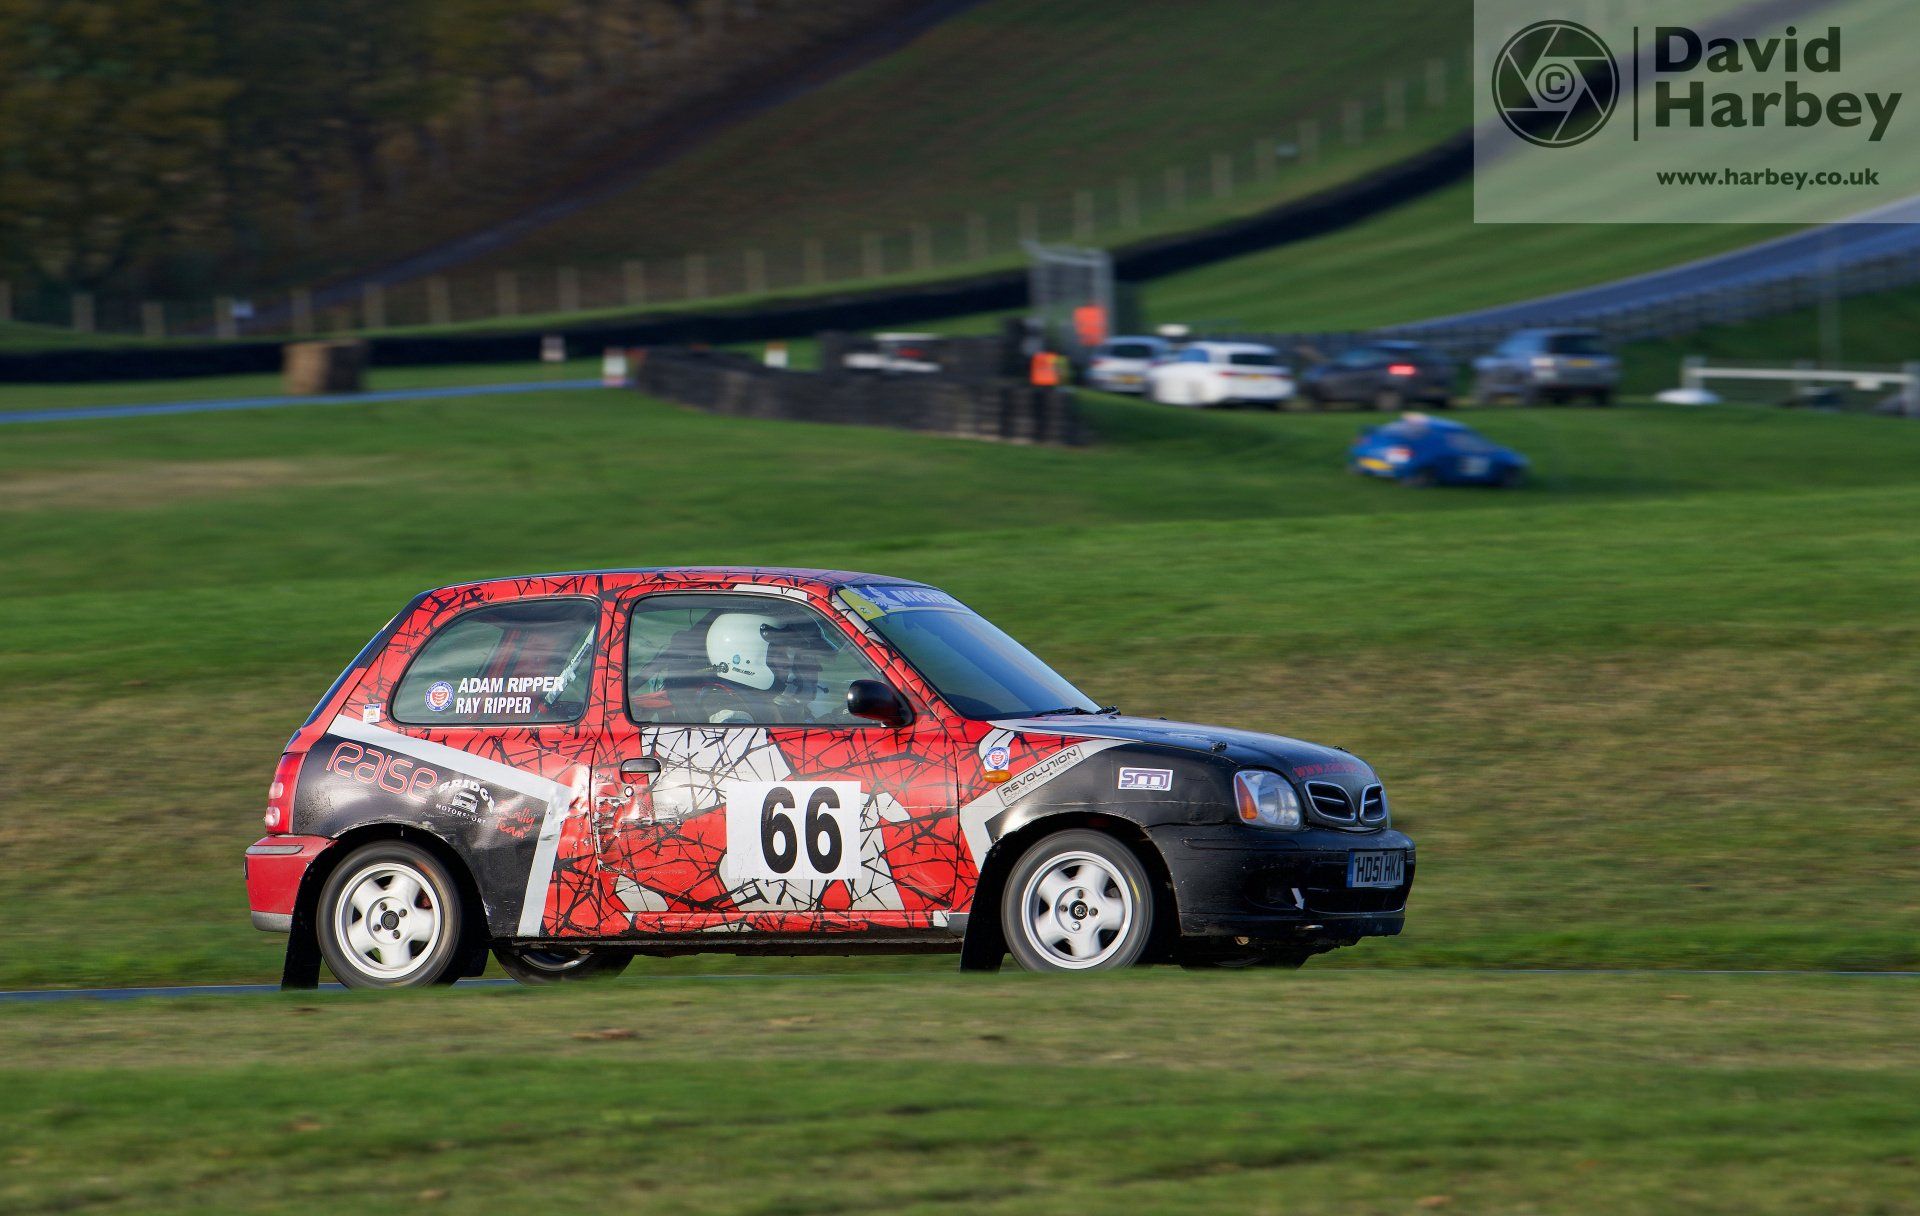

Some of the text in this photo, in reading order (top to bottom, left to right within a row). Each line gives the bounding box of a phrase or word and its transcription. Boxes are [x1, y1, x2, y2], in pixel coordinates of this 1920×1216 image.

[889, 590, 962, 609] MICHEL
[458, 676, 564, 693] ADAM RIPPER
[456, 697, 531, 714] RAY RIPPER
[1002, 749, 1077, 796] REVOLUTION
[436, 803, 486, 824] MOTORSORT
[760, 786, 842, 874] 66
